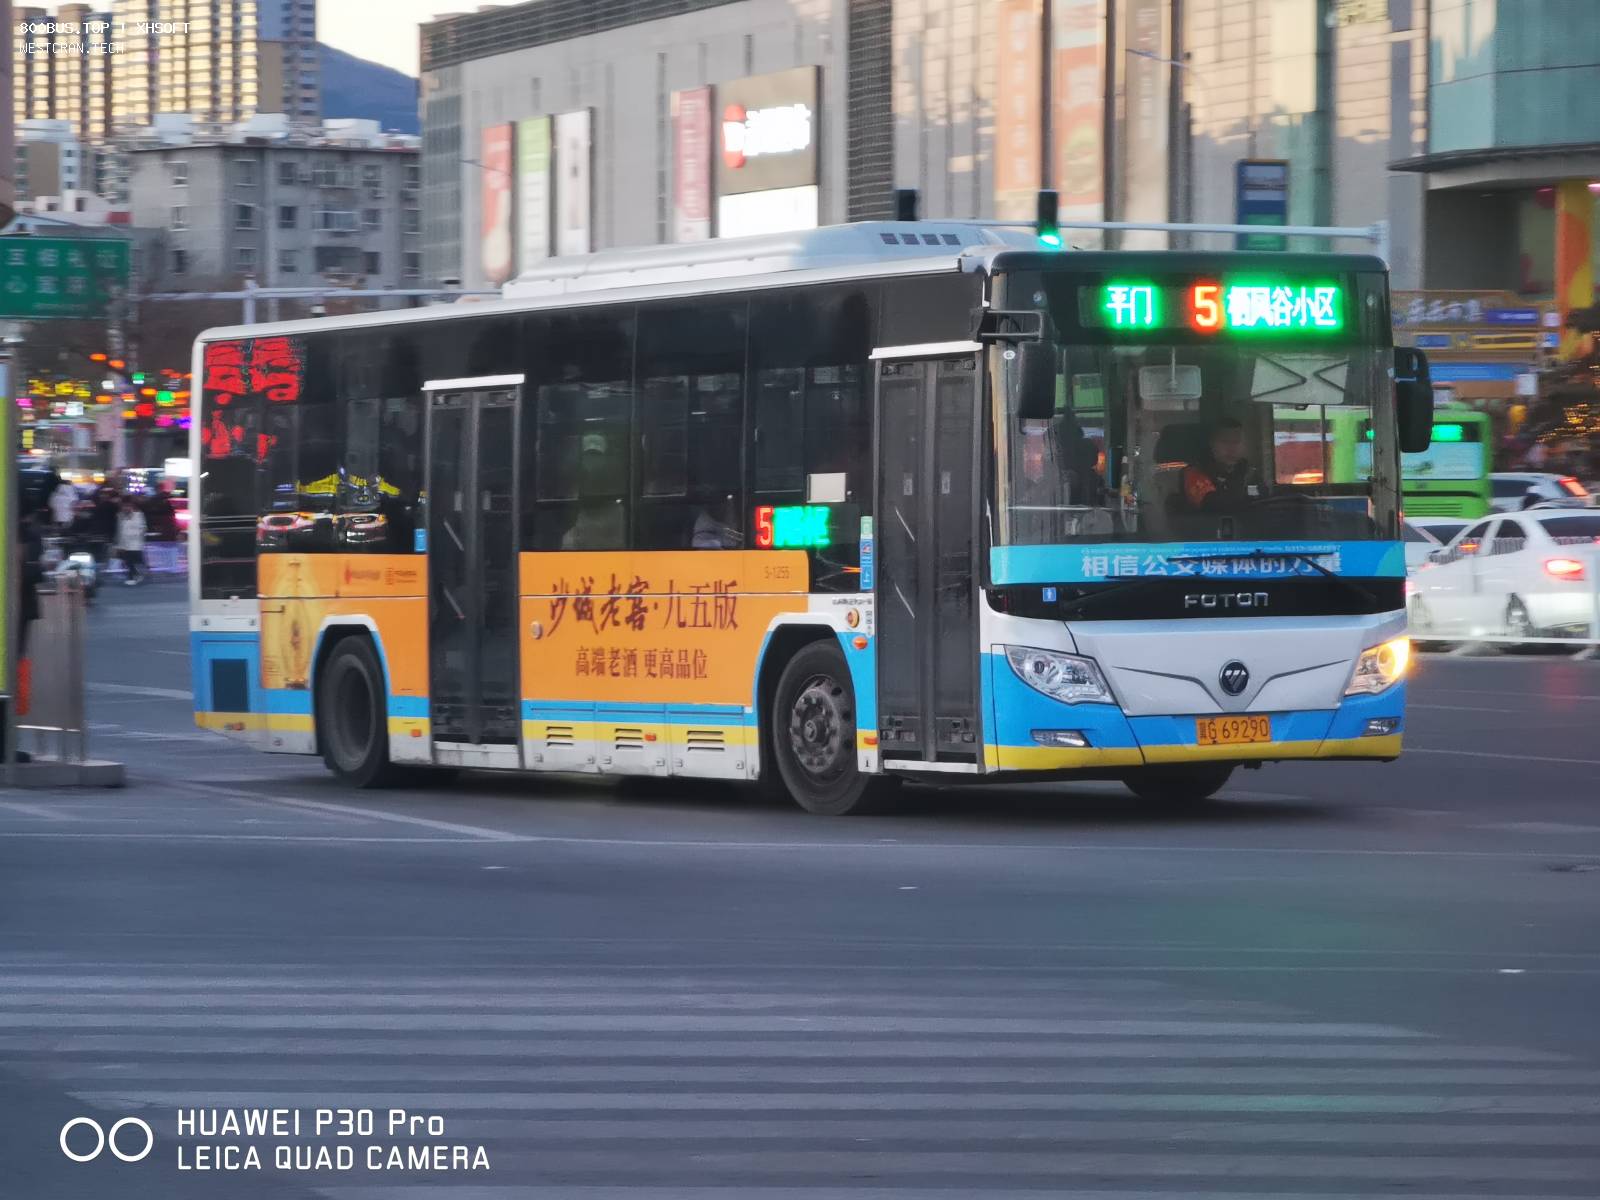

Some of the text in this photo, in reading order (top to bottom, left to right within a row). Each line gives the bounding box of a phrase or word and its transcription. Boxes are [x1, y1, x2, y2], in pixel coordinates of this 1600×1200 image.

[1194, 286, 1219, 326] 5
[759, 507, 773, 547] 5
[1184, 592, 1269, 609] FOTON
[644, 647, 707, 680] 更高品位
[1222, 719, 1269, 739] 69290
